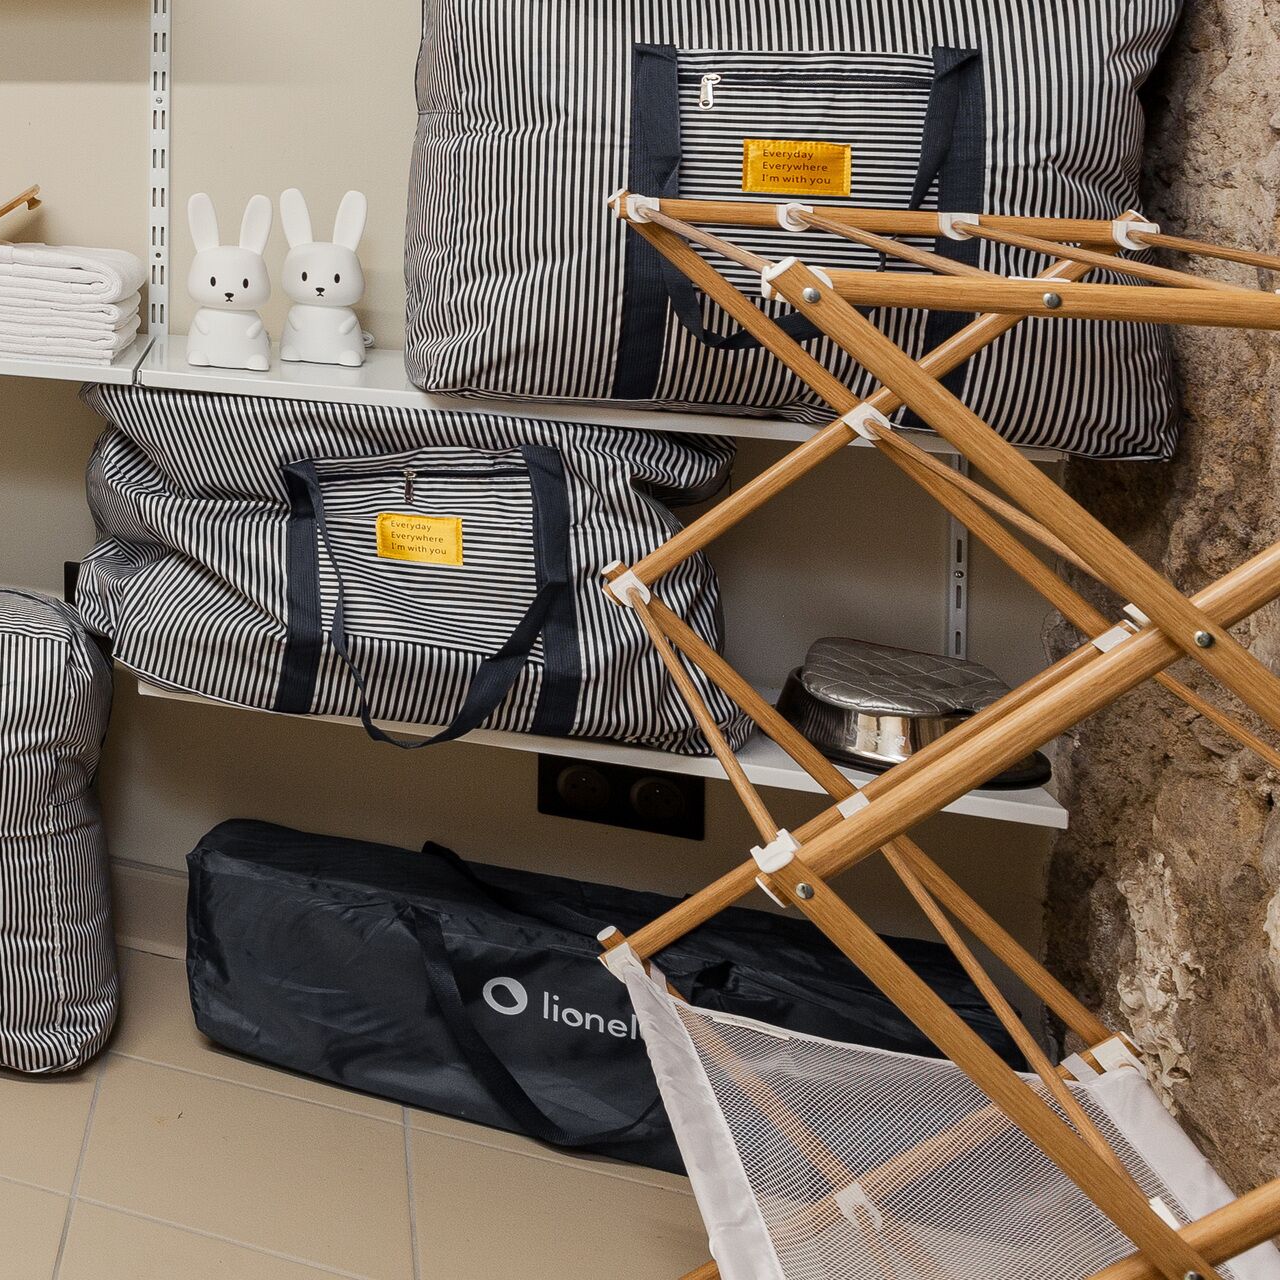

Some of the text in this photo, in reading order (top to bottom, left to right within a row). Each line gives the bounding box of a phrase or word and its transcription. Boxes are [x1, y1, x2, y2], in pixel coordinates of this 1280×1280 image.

[762, 149, 814, 160] Everyday
[762, 161, 828, 173] Everywhere
[761, 174, 832, 186] I'm with you
[391, 521, 432, 532] Everyday
[391, 532, 444, 543] Everywhere
[391, 543, 405, 551] I'm
[408, 544, 427, 553] with
[542, 990, 640, 1040] lionel
